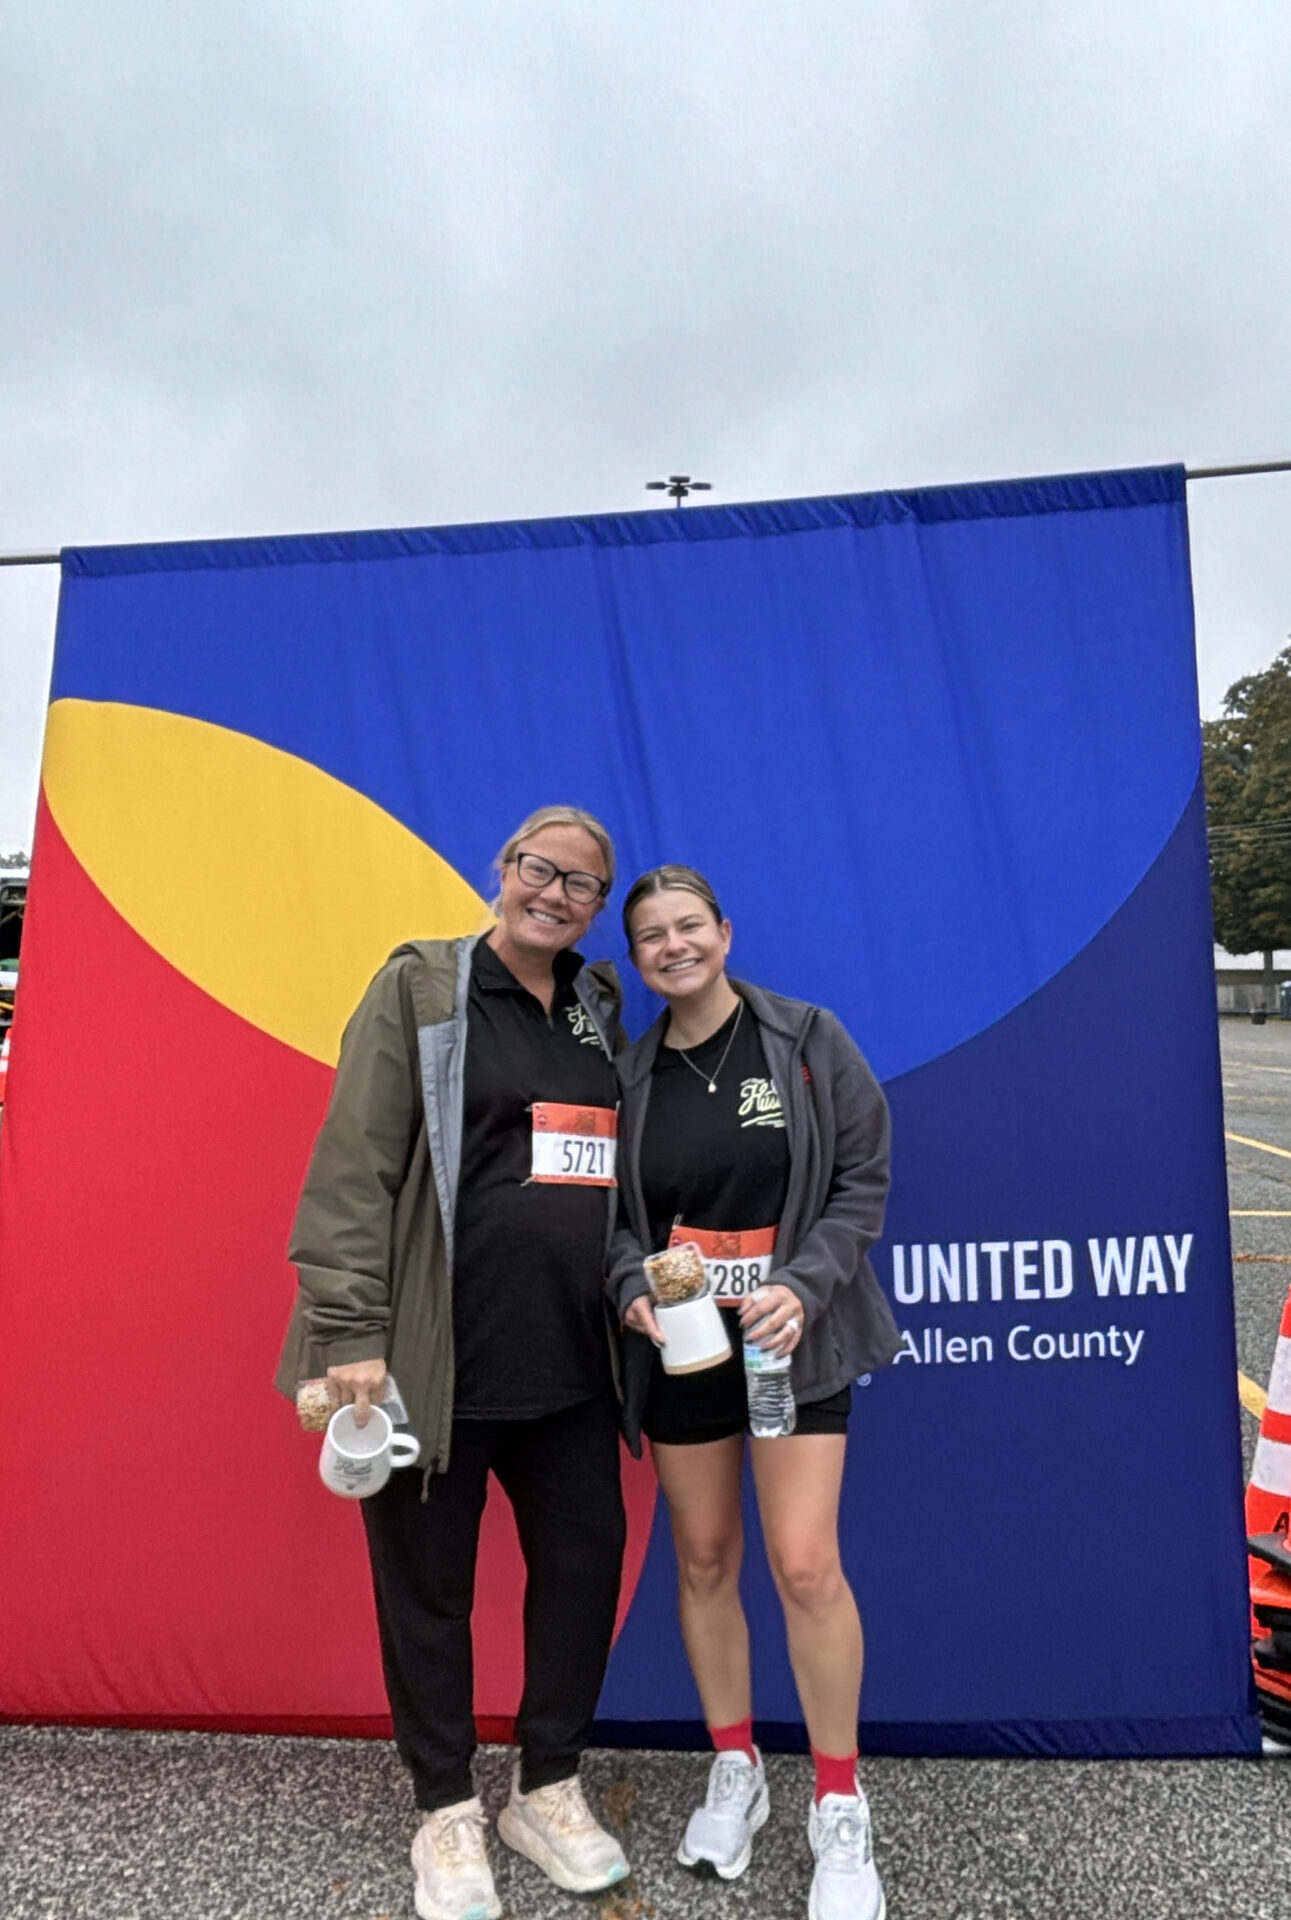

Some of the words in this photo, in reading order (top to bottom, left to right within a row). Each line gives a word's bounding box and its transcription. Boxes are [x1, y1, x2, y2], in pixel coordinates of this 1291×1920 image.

[562, 1140, 605, 1174] 5721
[705, 1262, 760, 1296] 288
[893, 1239, 1073, 1304] UNITED
[1088, 1233, 1194, 1297] WAY
[892, 1327, 993, 1365] Allen
[1007, 1325, 1145, 1365] County
